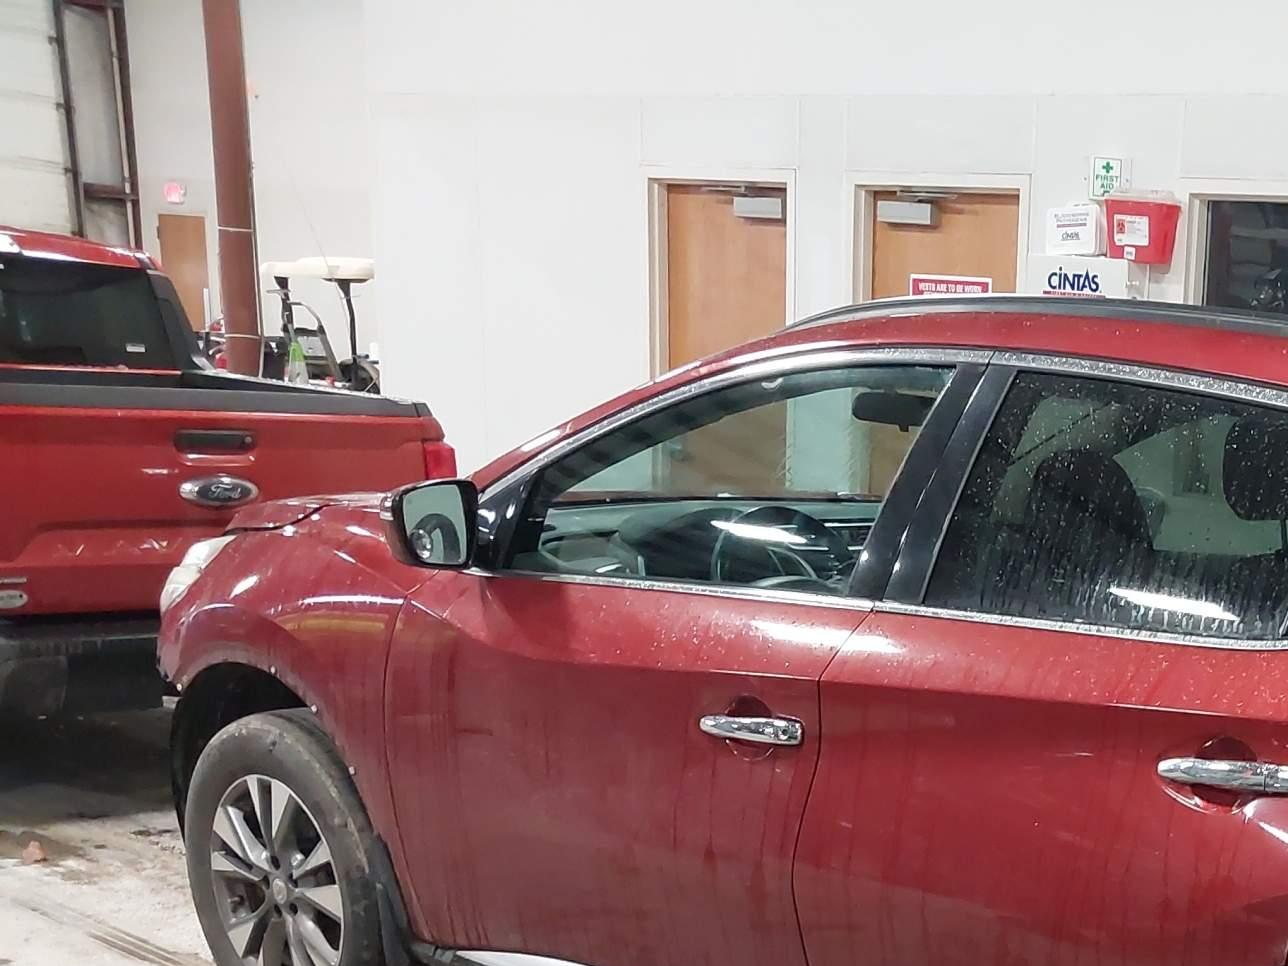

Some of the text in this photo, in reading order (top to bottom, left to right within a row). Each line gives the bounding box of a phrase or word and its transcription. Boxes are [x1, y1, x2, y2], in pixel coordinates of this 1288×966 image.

[1095, 174, 1119, 183] FIRST
[1100, 182, 1114, 190] AID
[947, 284, 956, 293] TO
[208, 483, 241, 499] Ford
